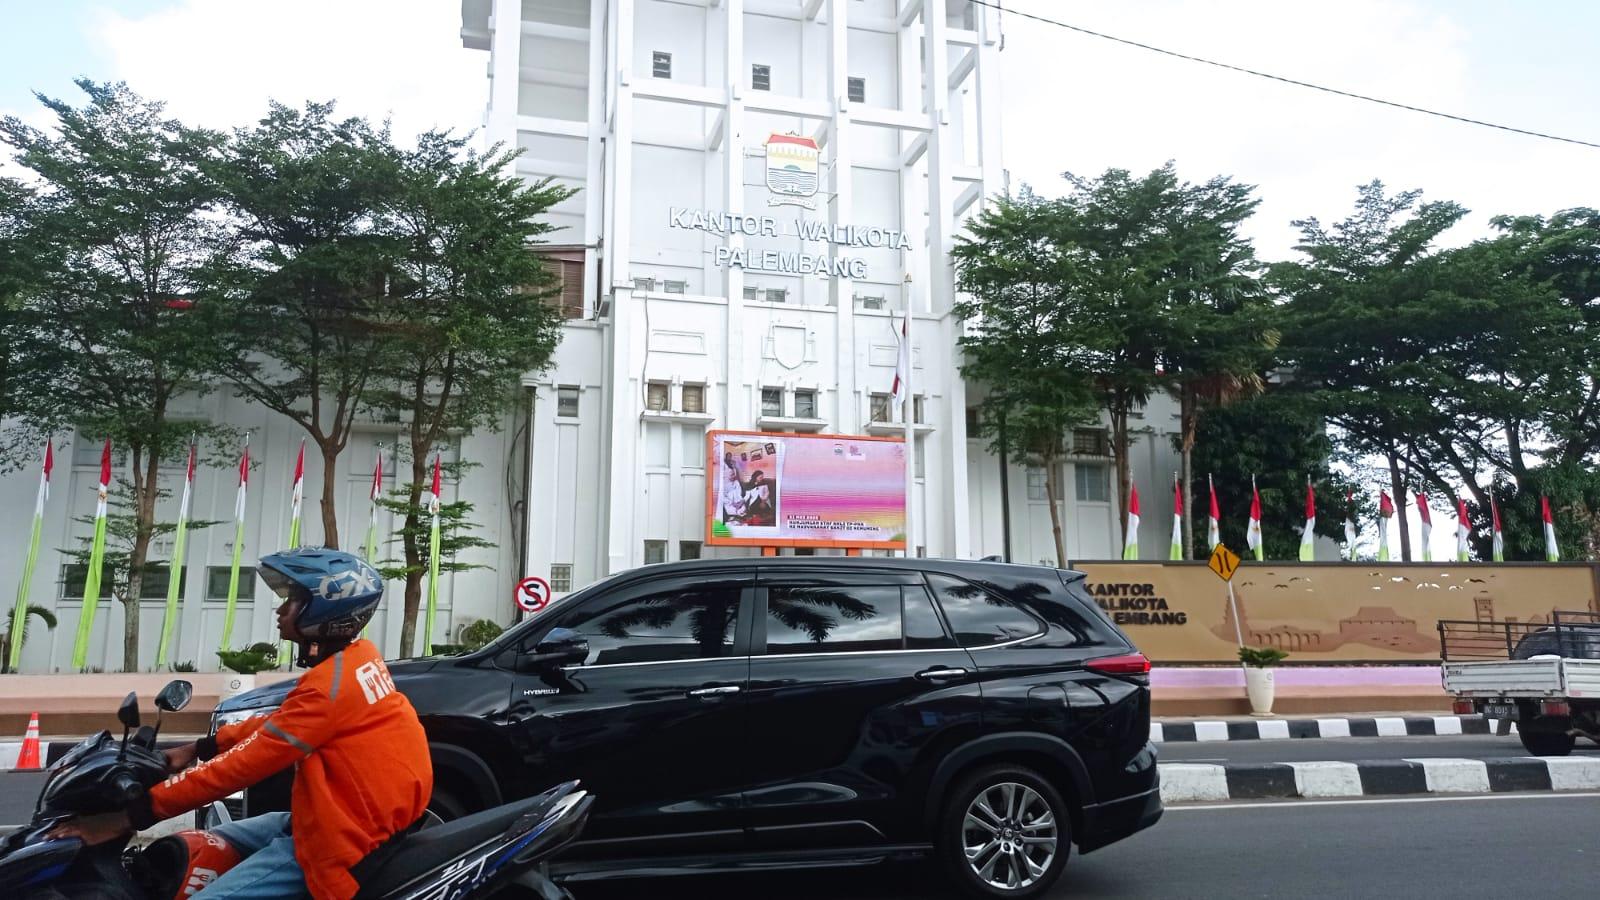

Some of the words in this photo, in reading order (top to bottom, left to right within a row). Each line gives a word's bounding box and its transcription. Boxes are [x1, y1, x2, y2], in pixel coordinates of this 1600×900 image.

[669, 207, 777, 237] KANTOR
[795, 219, 913, 250] WALIKOTA
[715, 245, 867, 279] PALEMBANG
[1083, 583, 1154, 596] KANTOR
